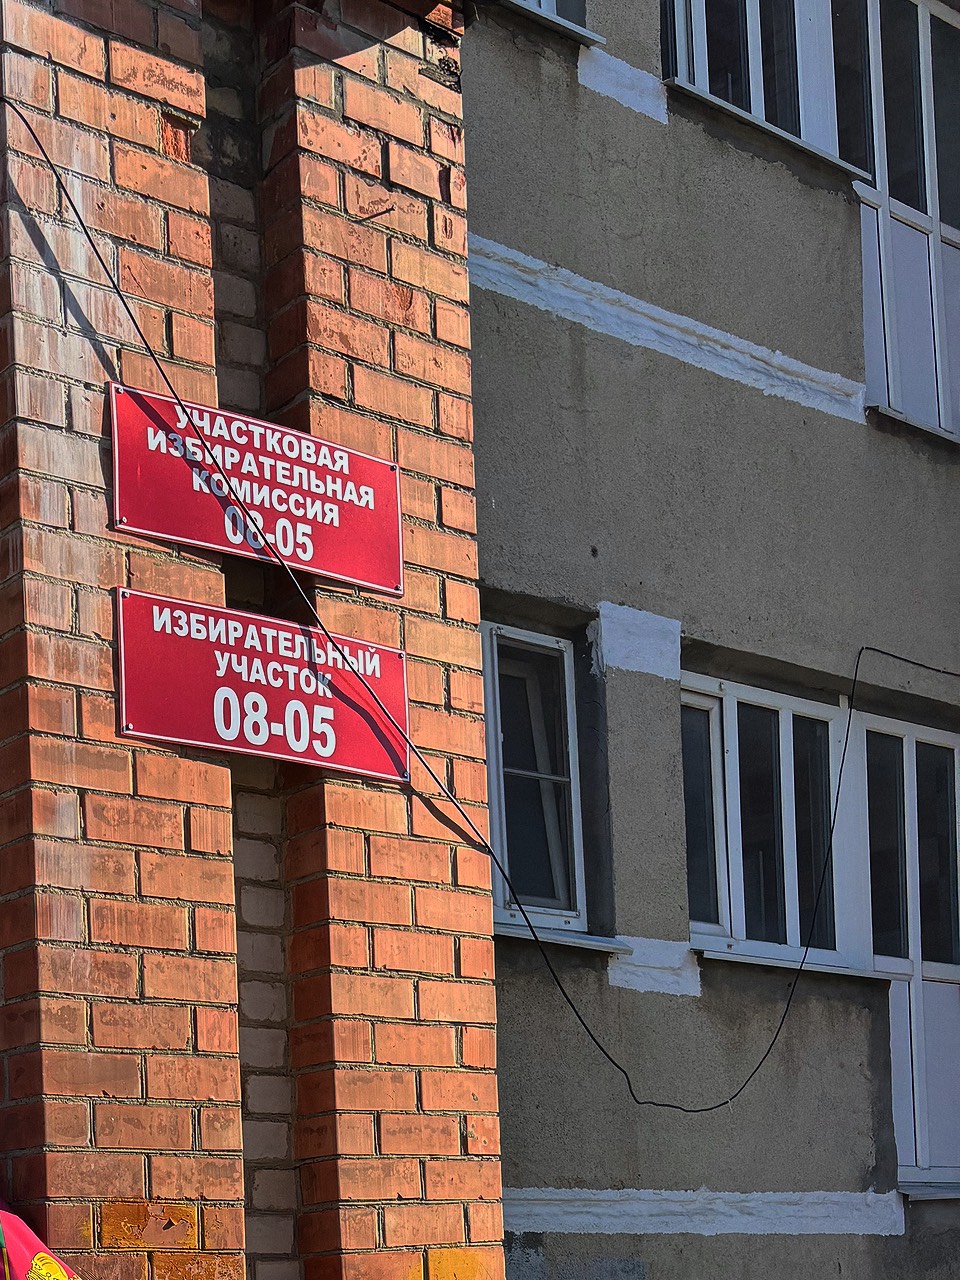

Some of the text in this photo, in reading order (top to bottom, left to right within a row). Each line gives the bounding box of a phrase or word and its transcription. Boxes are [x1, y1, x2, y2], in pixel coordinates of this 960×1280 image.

[147, 426, 375, 510] ИЗБИРАТЕЛЬНАЯ
[173, 404, 350, 474] УЧАСТКОВАЯ
[192, 467, 340, 527] КОМИССИЯ
[223, 505, 315, 562] 08-05
[152, 604, 381, 679] ИЗБИРАТЕЛЬНЫЙ
[214, 650, 333, 699] УЧАСТОК
[212, 686, 338, 758] 08-05
